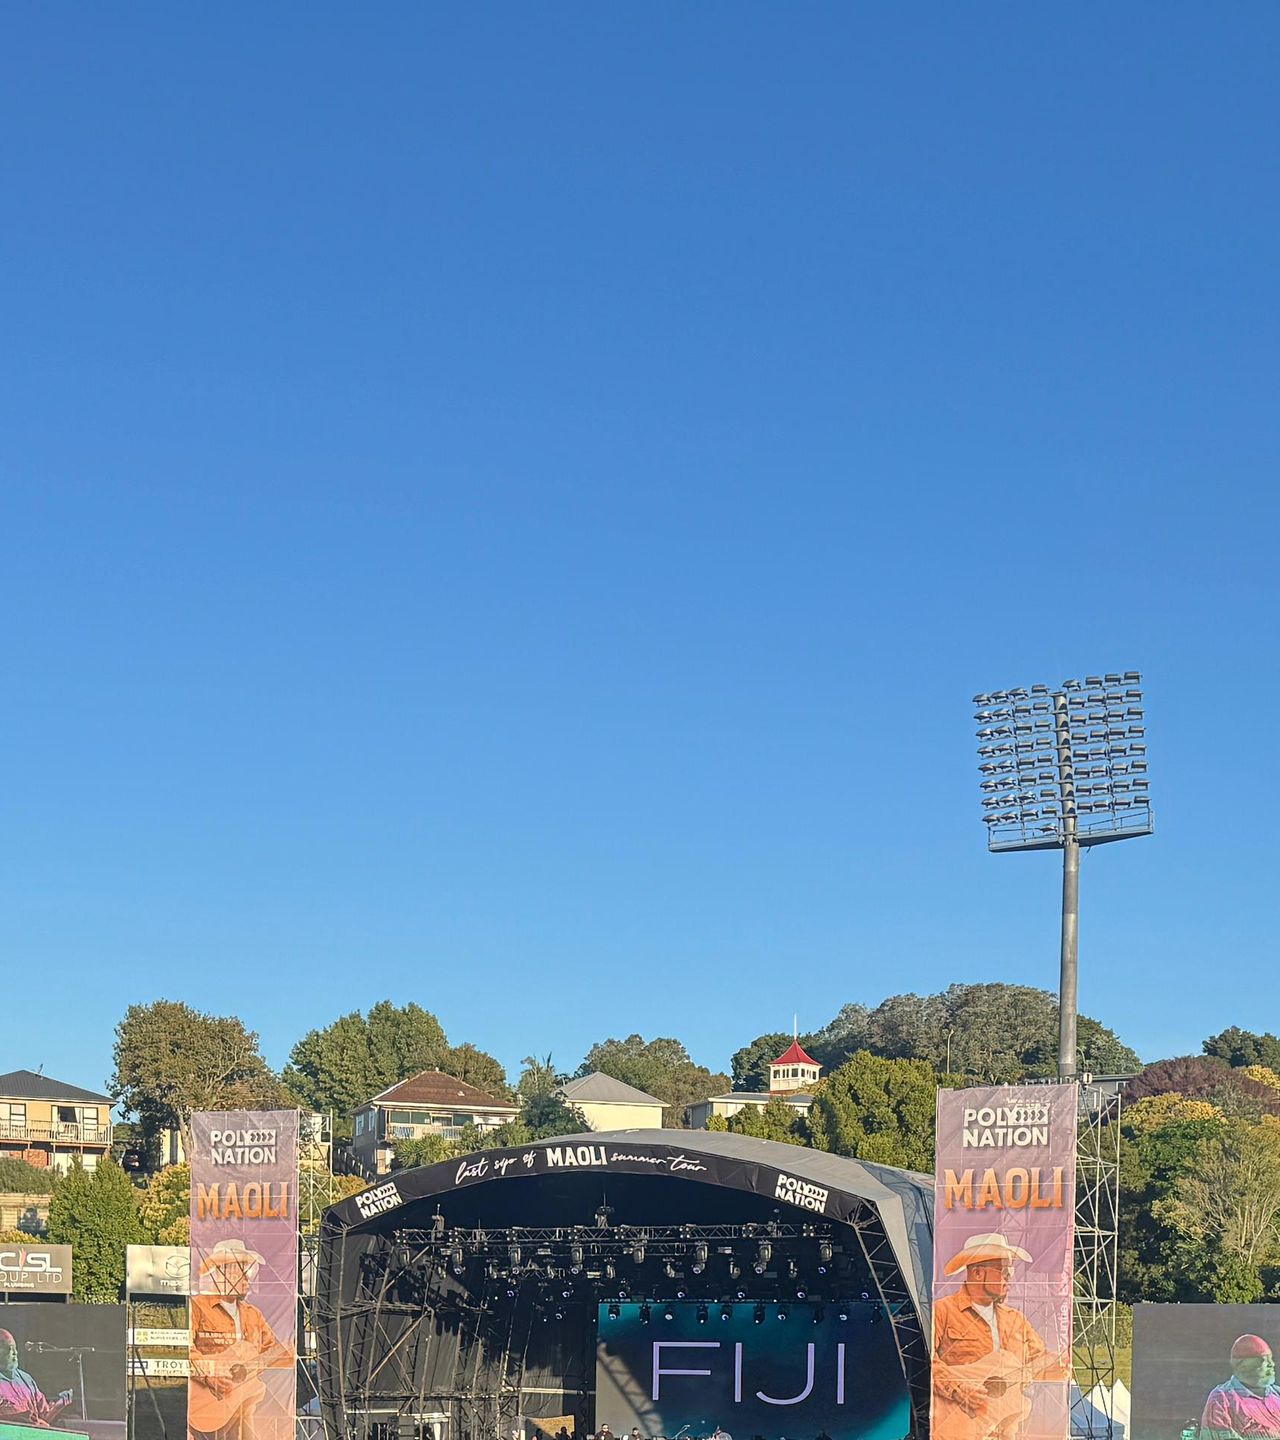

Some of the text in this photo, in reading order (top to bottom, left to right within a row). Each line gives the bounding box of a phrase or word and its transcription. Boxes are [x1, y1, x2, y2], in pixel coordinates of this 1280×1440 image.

[963, 1107, 1016, 1127] POLY
[210, 1129, 251, 1146] POLY
[963, 1127, 1048, 1148] NATION
[211, 1147, 276, 1164] NATION
[455, 1161, 489, 1185] last
[546, 1146, 608, 1167] MAOLI
[777, 1173, 808, 1193] POLY
[944, 1167, 1064, 1209] MAOLI
[196, 1182, 289, 1219] MAOLI
[355, 1187, 383, 1208] POLY
[360, 1193, 403, 1218] NATION
[774, 1186, 826, 1213] NATION
[37, 1272, 62, 1283] LTD
[652, 1341, 845, 1406] FIJI
